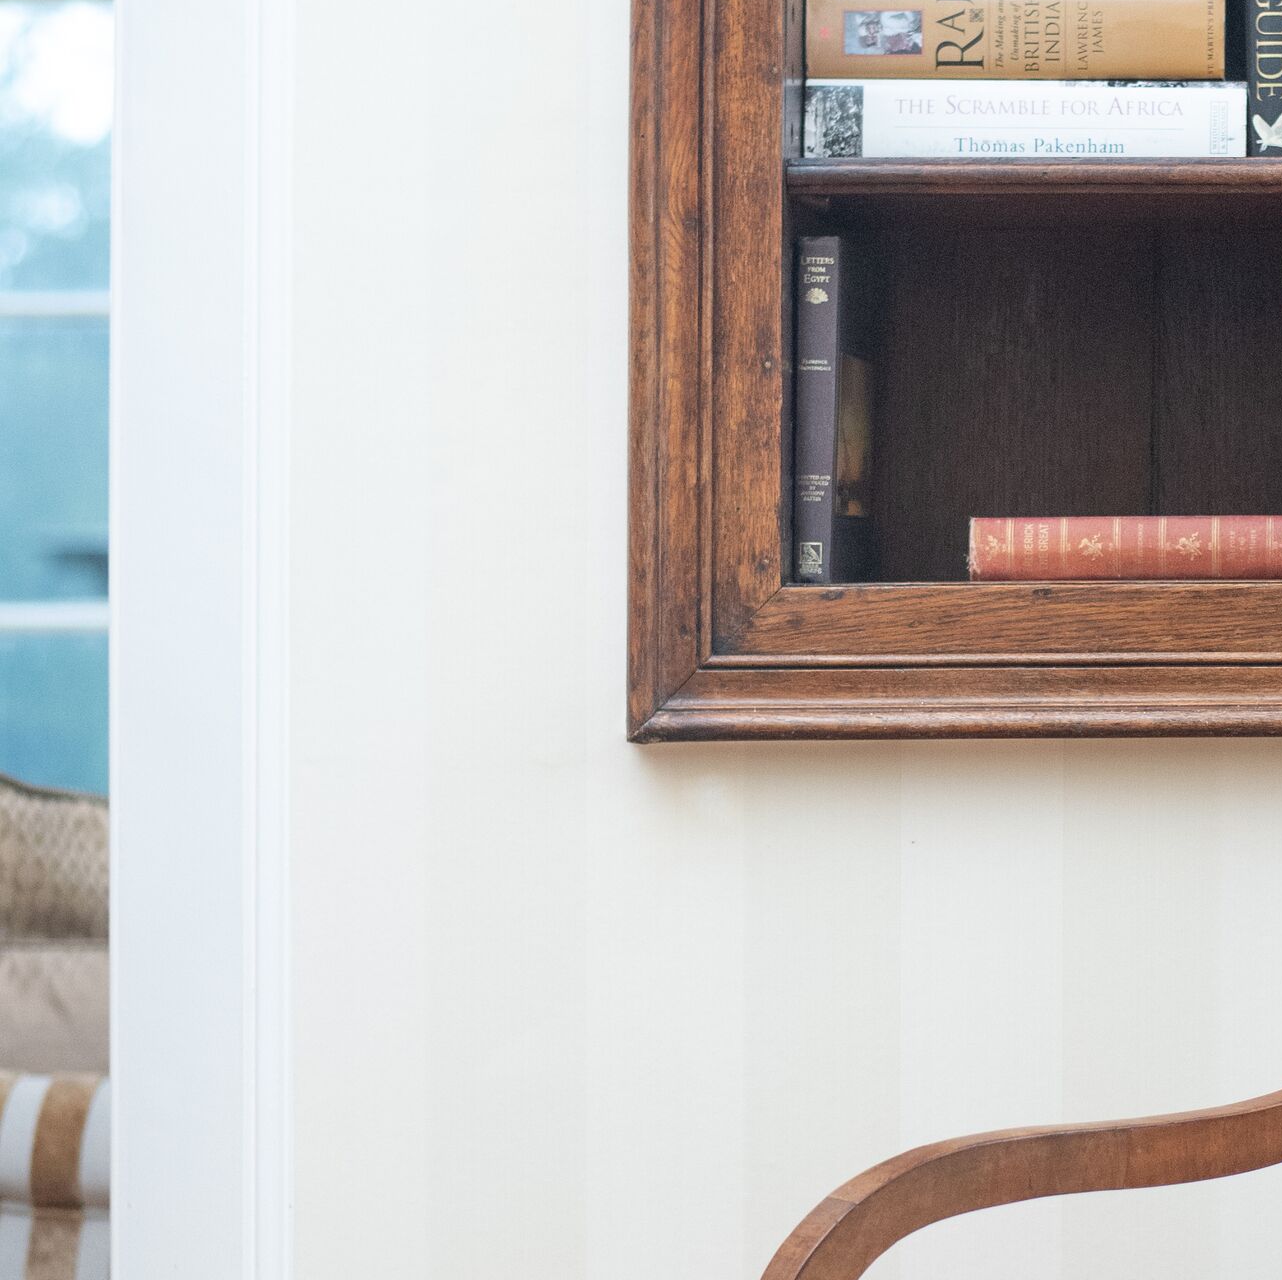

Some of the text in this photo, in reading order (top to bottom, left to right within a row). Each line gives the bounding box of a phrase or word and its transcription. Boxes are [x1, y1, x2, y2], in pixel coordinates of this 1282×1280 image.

[1045, 1, 1061, 62] INDIA
[1092, 10, 1104, 54] JAMES
[896, 93, 1184, 117] THE SCRAMBLE FOR AFRICA
[953, 136, 1126, 155] Thomas Pakenham
